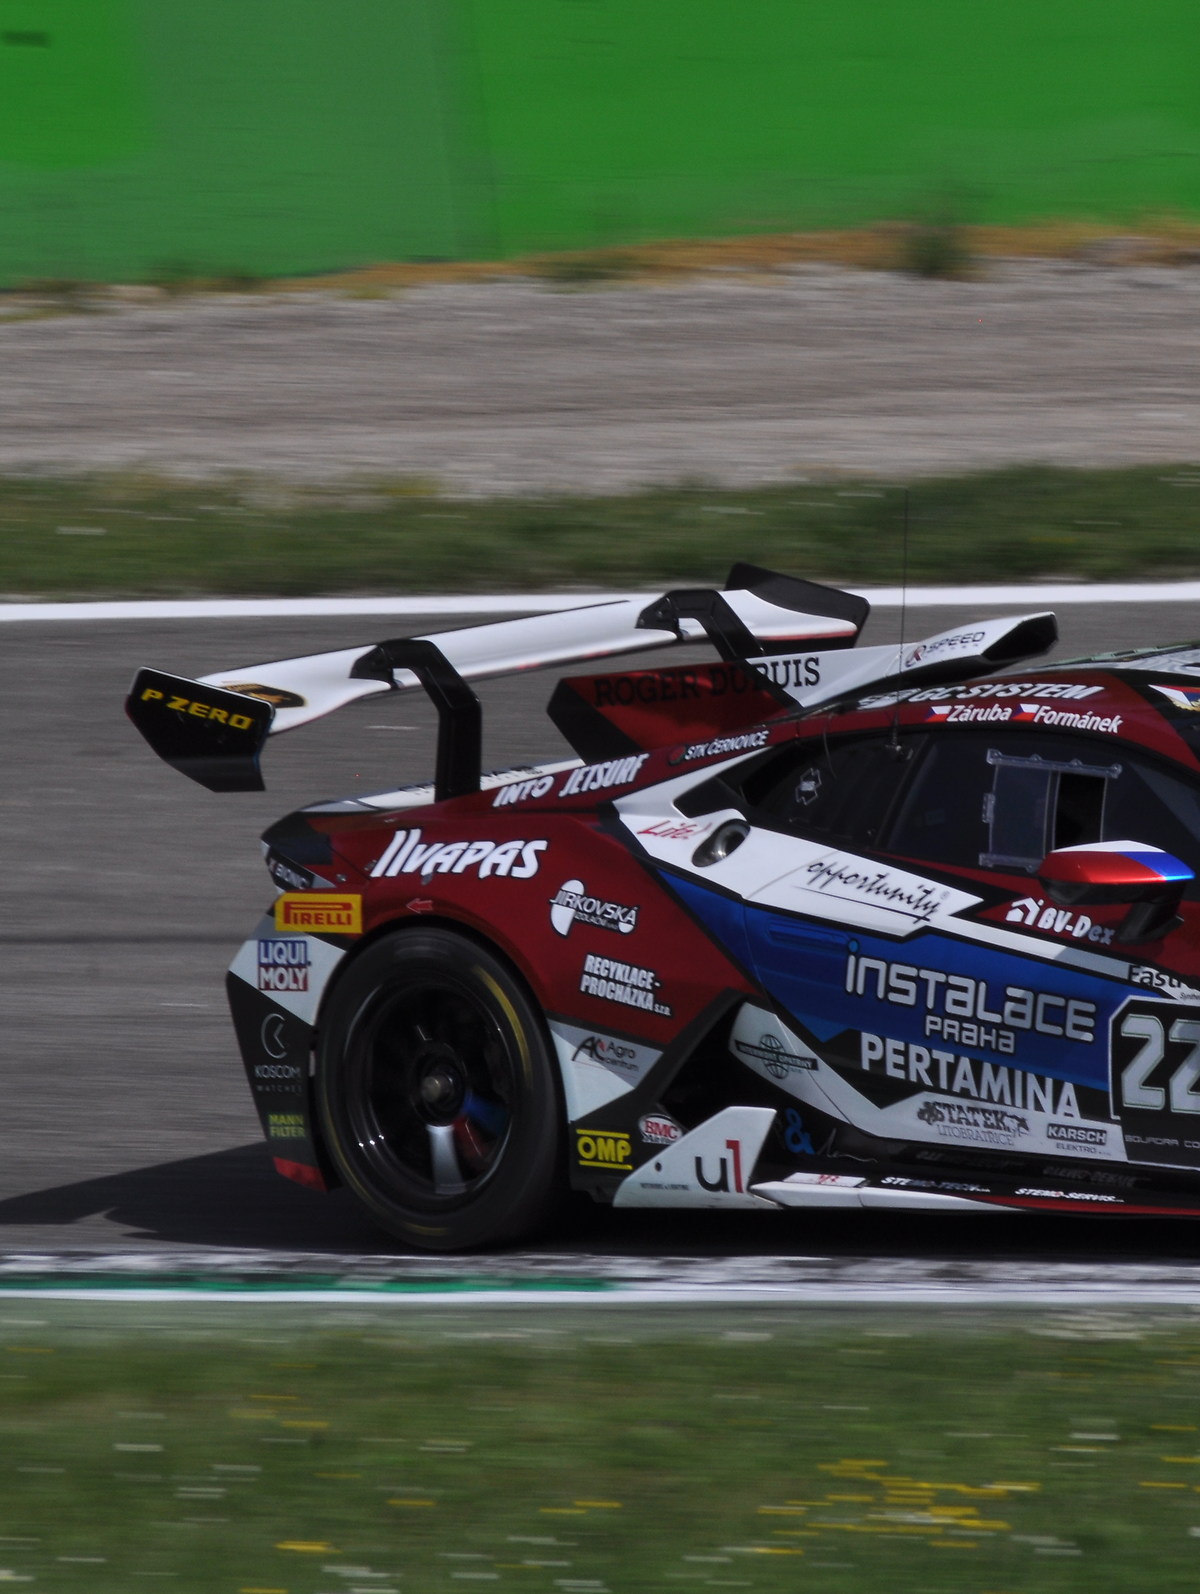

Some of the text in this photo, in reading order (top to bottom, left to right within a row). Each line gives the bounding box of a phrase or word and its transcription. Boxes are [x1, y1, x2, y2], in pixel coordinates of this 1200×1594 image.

[594, 672, 699, 707] ROGER
[955, 683, 1105, 702] SYSTEM
[140, 687, 255, 731] P ZERO
[946, 704, 1124, 735] Záruba Formánek
[558, 752, 650, 798] JETSURF
[806, 859, 942, 925] opportunity
[282, 901, 354, 926] PIRELLI
[259, 941, 307, 965] LIQUI
[259, 966, 308, 991] MOLY
[580, 973, 654, 1011] PROCHÁZKA
[859, 1031, 1082, 1120] PERTAMINA
[268, 1113, 305, 1126] MANN
[645, 1119, 679, 1141] BMC
[931, 1101, 1010, 1134] STATEK
[269, 1125, 306, 1138] FILTER
[1049, 1126, 1107, 1144] KARSCH
[577, 1136, 632, 1163] OMP
[1055, 1142, 1098, 1155] ELEKTRO
